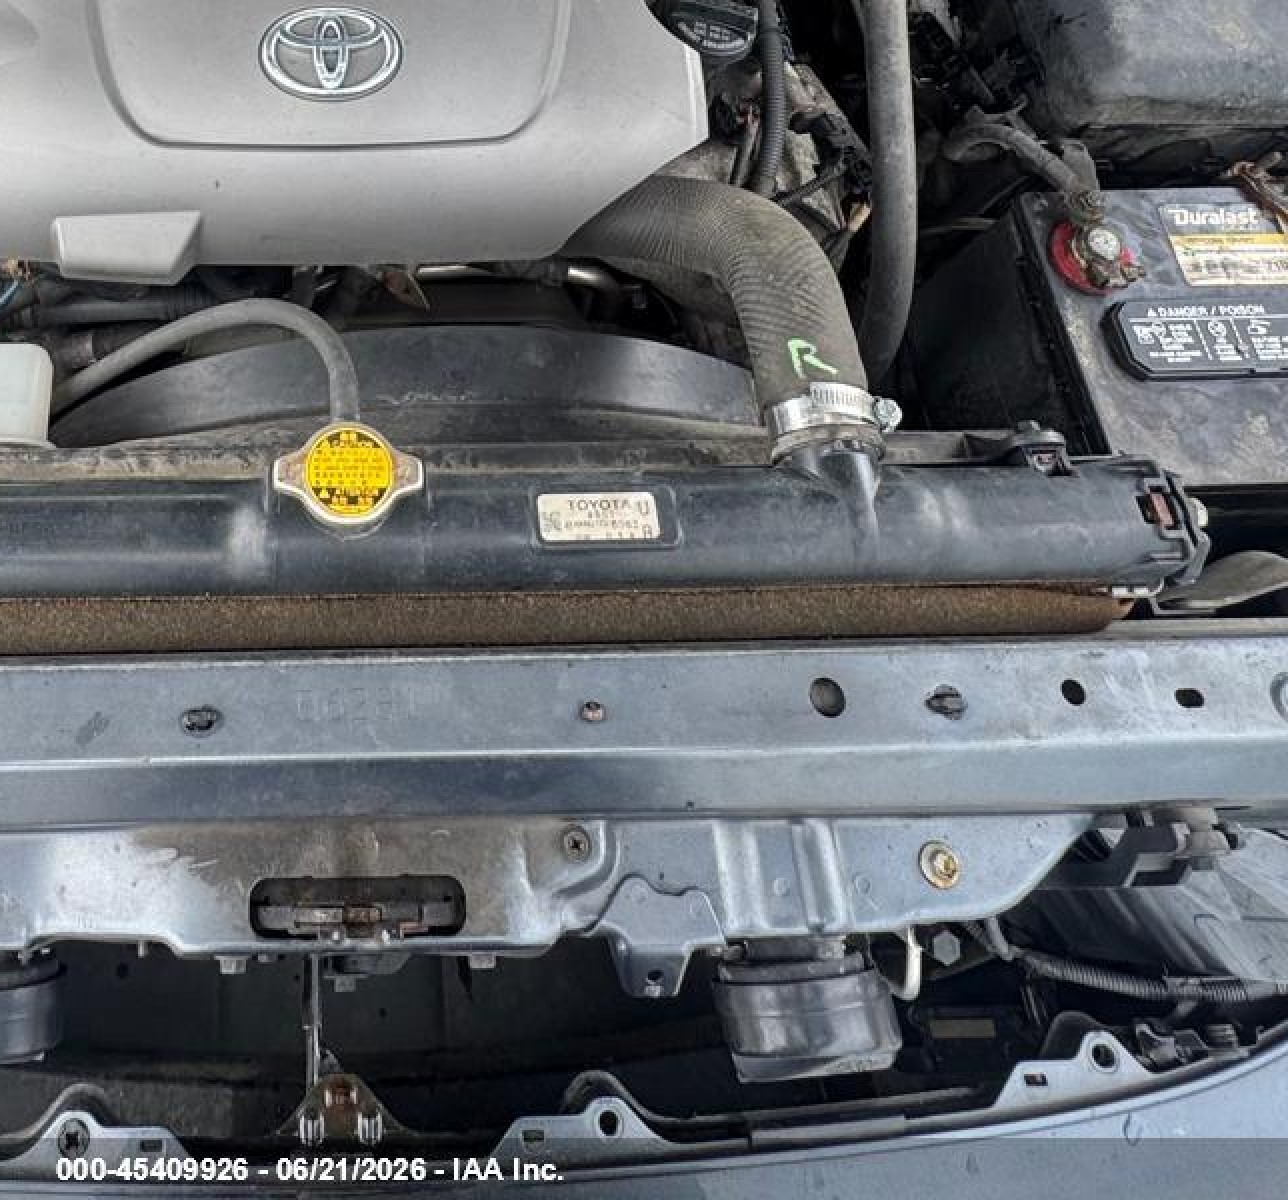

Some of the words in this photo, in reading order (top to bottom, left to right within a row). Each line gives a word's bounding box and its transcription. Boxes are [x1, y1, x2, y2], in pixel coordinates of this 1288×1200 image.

[1167, 207, 1259, 225] Duralast
[788, 338, 838, 379] R
[567, 499, 632, 511] TOYOTA
